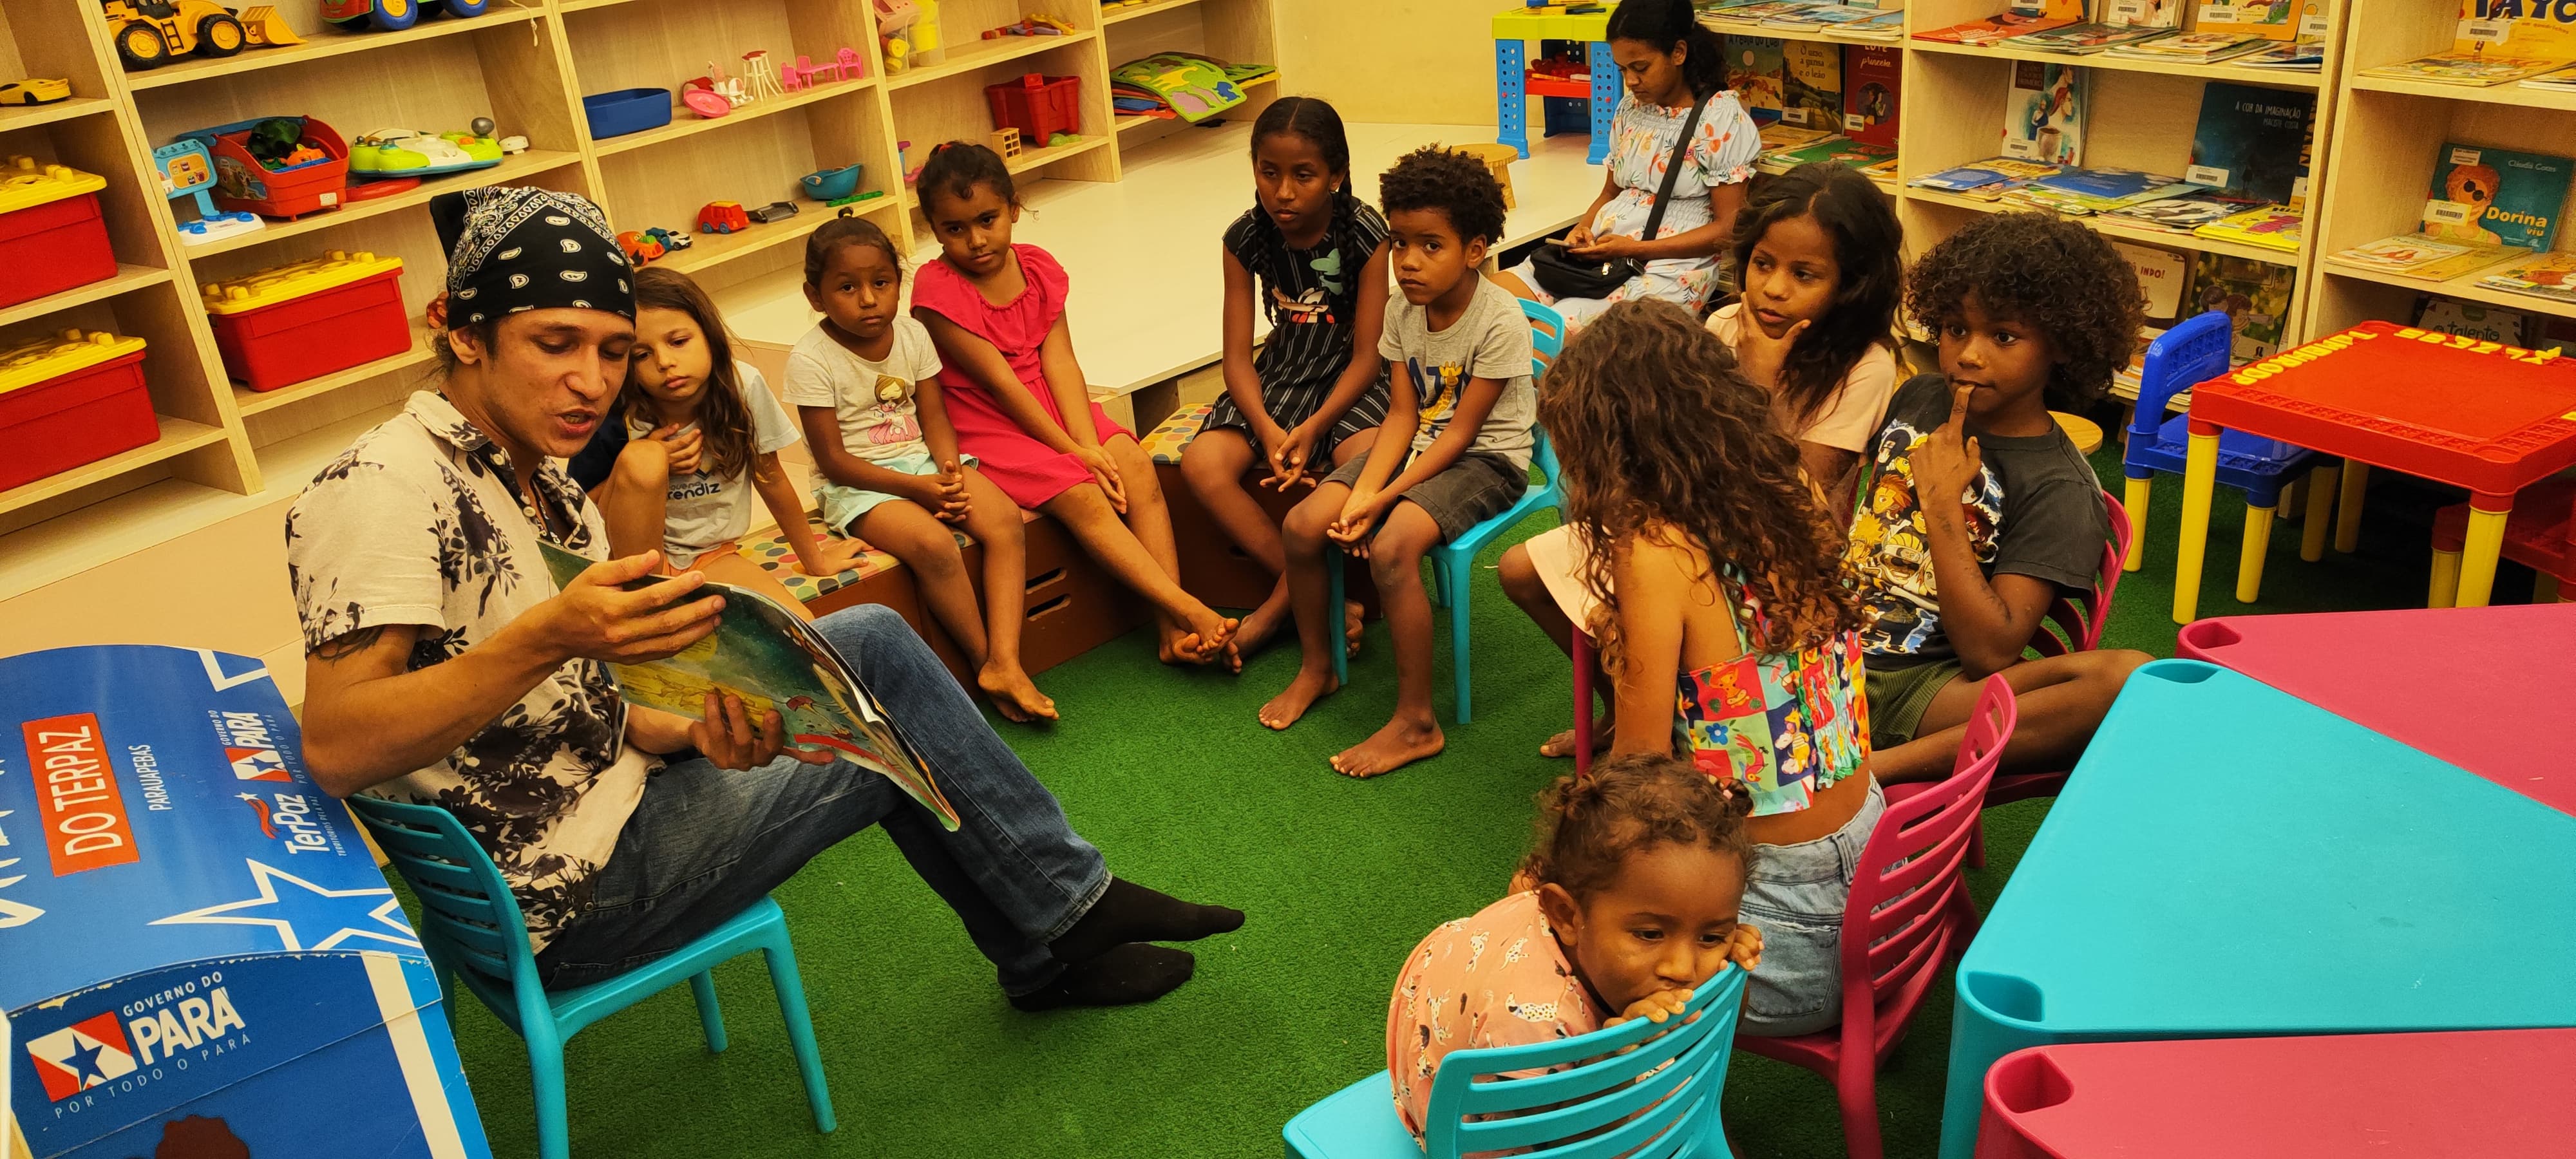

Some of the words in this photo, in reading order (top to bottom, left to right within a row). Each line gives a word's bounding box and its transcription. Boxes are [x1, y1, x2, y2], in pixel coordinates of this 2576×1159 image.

[1800, 46, 1806, 55] O
[2235, 100, 2240, 111] A
[2242, 102, 2253, 112] COR
[2255, 103, 2263, 113] DA
[2486, 206, 2548, 228] Dorina
[2526, 227, 2544, 237] viu
[2141, 266, 2165, 279] INDO!
[2447, 321, 2500, 341] talento
[667, 483, 721, 500] rendiz
[208, 710, 219, 719] DO
[212, 719, 232, 746] GOVERNO
[38, 726, 109, 813] TERPAZ
[128, 744, 173, 811] PARAUAPEBAS
[59, 812, 123, 856] DO
[272, 793, 330, 854] TerPaz
[123, 981, 196, 1017] GOVERNO
[201, 971, 222, 988] DO
[55, 1095, 95, 1119] POR
[108, 1068, 162, 1098] TODO
[177, 1059, 188, 1070] O
